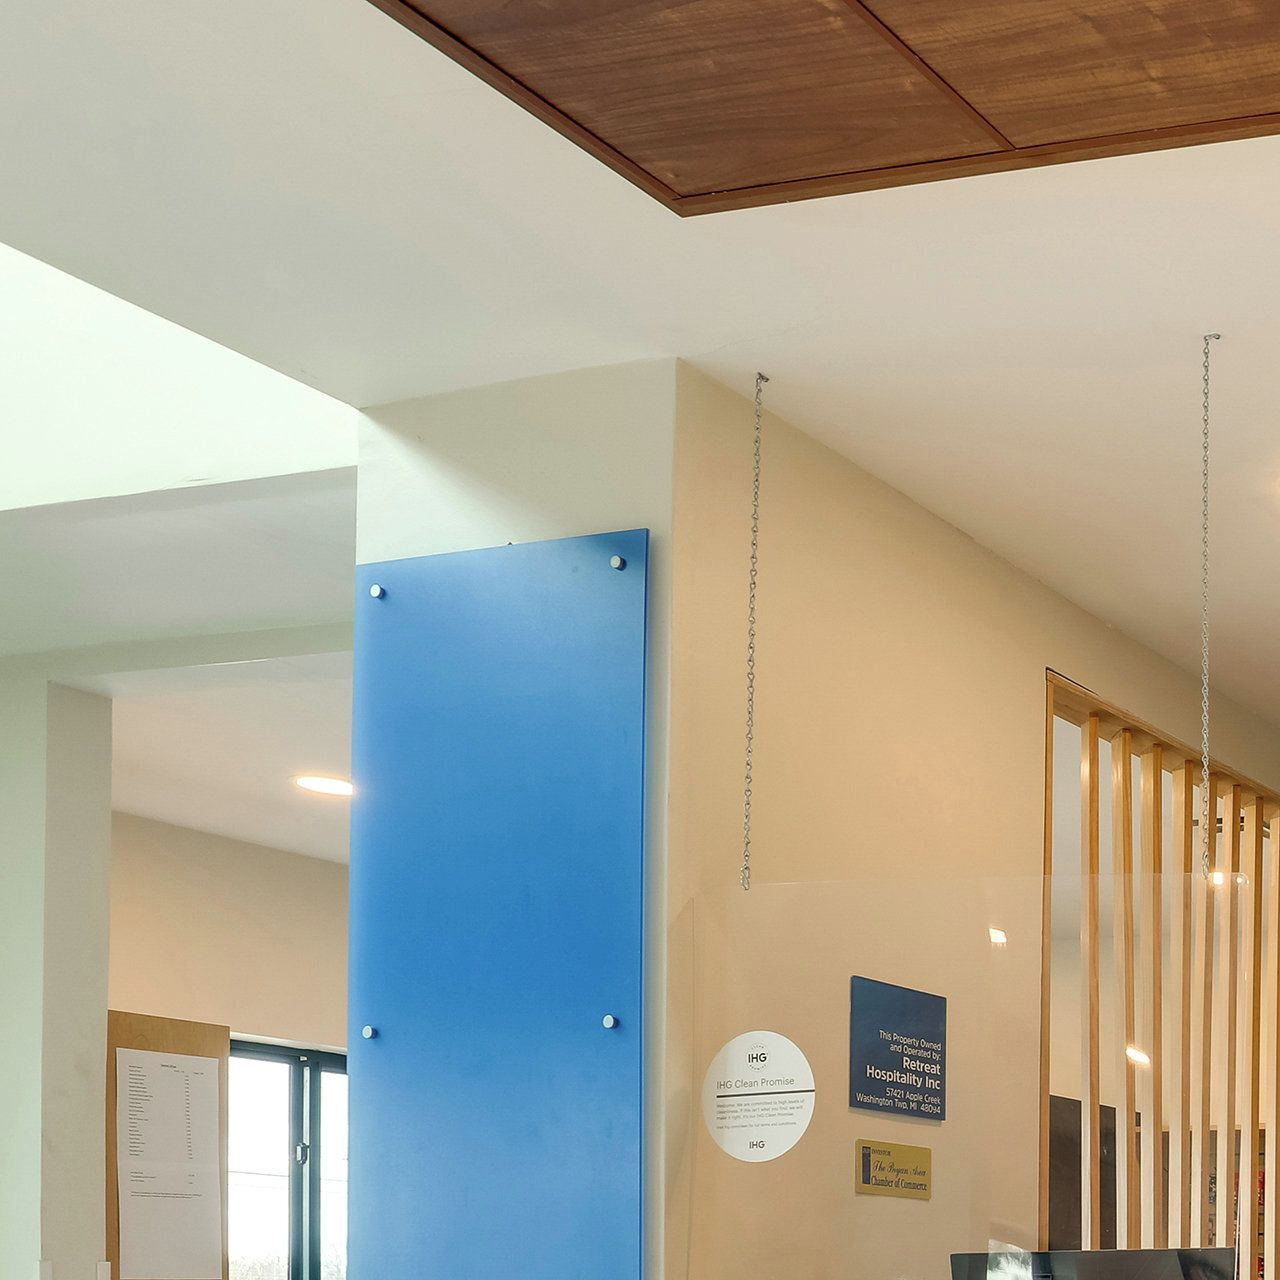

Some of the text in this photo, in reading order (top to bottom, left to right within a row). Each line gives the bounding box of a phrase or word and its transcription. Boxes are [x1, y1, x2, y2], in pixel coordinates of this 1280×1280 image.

[879, 1029, 941, 1051] This Property Owned
[748, 1053, 767, 1063] IHG
[890, 1044, 941, 1061] and Operated by:
[903, 1057, 941, 1075] Retreat
[716, 1077, 795, 1090] IHG Clean Promise
[866, 1065, 941, 1090] Hospitality Inc
[856, 1092, 894, 1107] Washington
[909, 1102, 917, 1110] MI
[920, 1103, 941, 1114] 48094
[886, 1087, 941, 1104] 57421 Apple Creek
[749, 1140, 765, 1149] IHG
[872, 1176, 928, 1191] Chamber of Commerce
